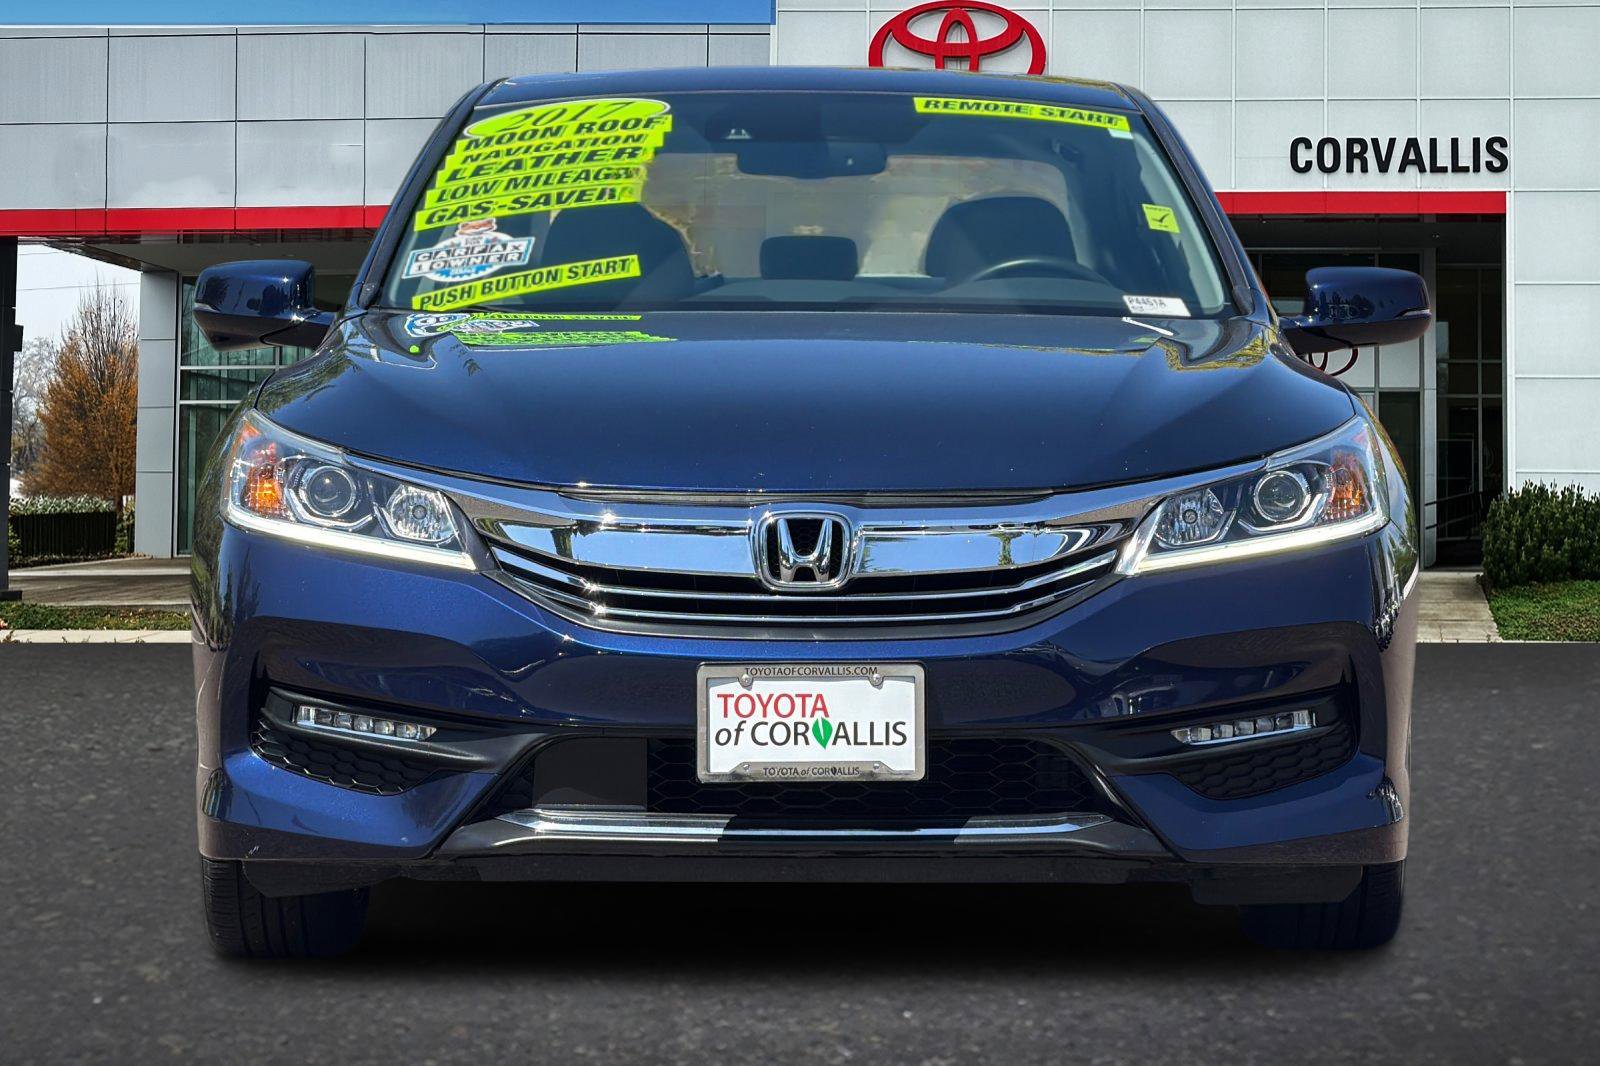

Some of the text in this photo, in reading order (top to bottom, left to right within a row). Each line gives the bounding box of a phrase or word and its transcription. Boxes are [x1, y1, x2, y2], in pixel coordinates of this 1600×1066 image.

[496, 102, 634, 132] 2017
[923, 100, 1120, 126] REMOTE START
[464, 115, 660, 151] MOON ROOF
[461, 133, 643, 164] NAVIGATION
[1290, 136, 1509, 174] CORVALLIS
[445, 146, 642, 183] LEATHER
[437, 182, 496, 204] LOW
[432, 252, 520, 270] OWNER
[420, 258, 632, 309] PUSH BUTTON START
[745, 666, 878, 676] TOYOTAOFCORVALLIS.COM
[716, 693, 830, 719] TOYOTA
[715, 720, 746, 746] of
[763, 767, 799, 776] TOYOTA
[800, 767, 810, 776] of
